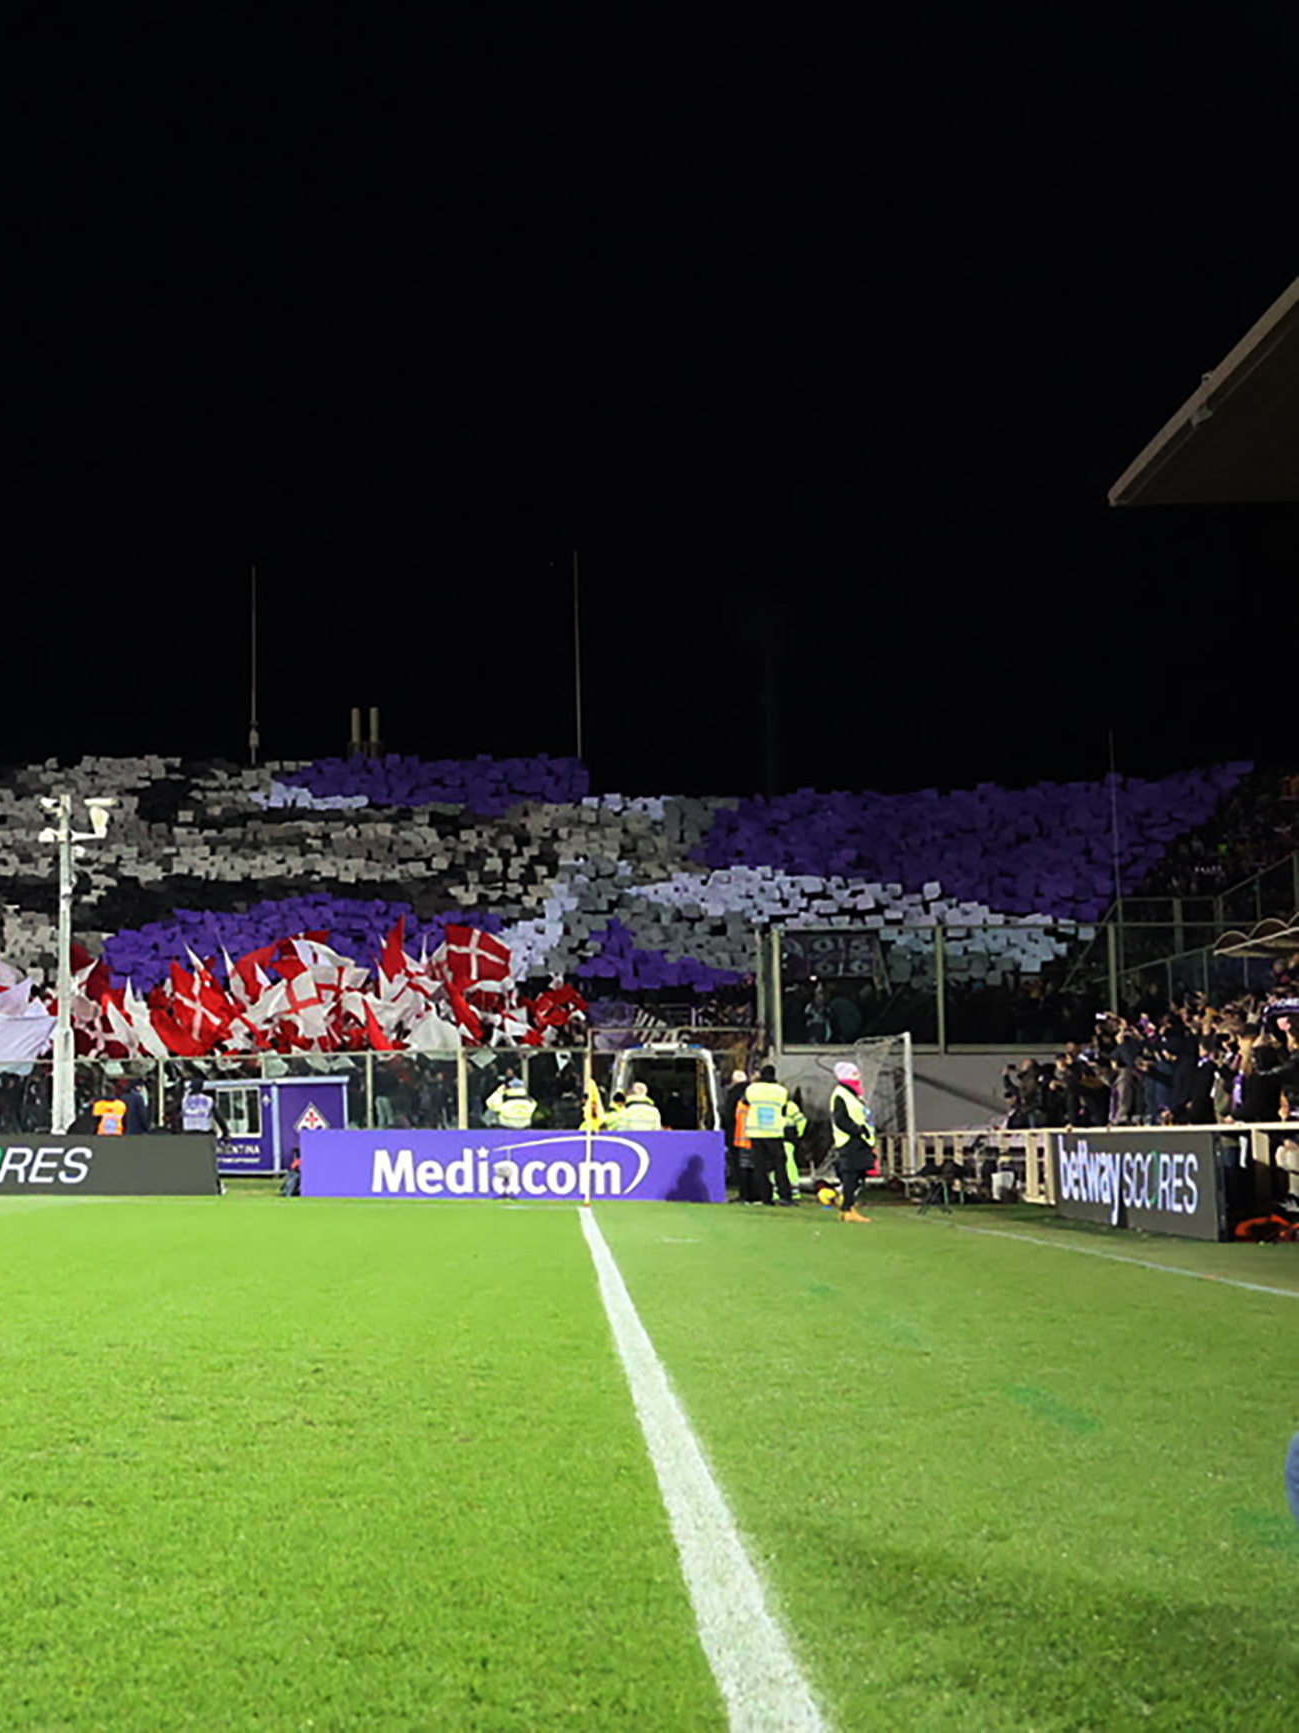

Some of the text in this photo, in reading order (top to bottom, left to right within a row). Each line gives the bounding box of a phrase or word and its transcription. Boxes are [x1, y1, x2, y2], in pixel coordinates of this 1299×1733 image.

[372, 1147, 621, 1194] Mediacom
[1058, 1134, 1198, 1225] betway SCORES
